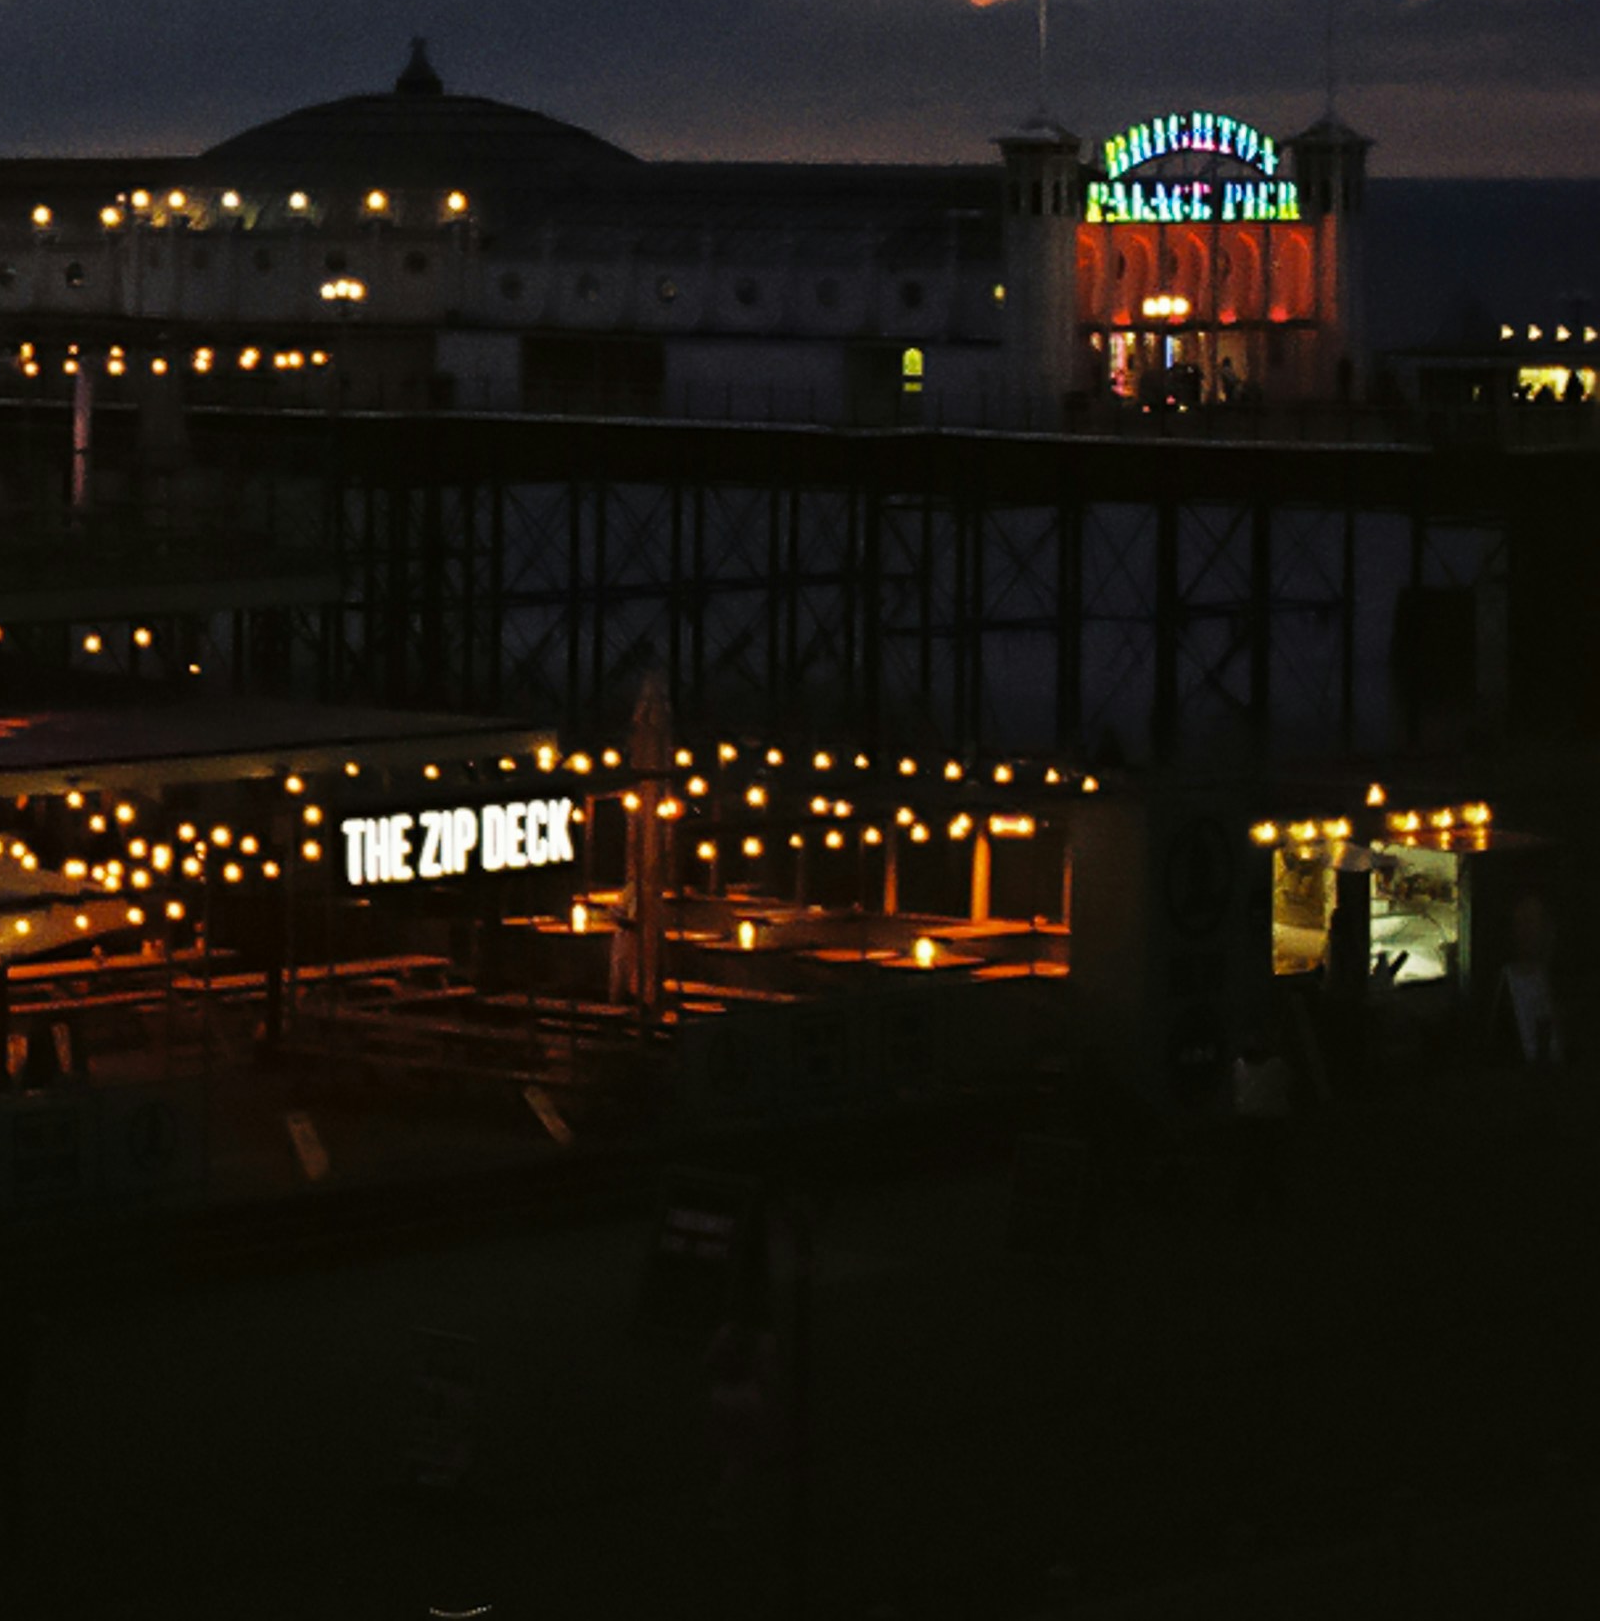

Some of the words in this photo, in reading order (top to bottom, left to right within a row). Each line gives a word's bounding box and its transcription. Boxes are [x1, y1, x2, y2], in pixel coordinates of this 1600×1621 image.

[1086, 182, 1212, 222] PALACE
[1221, 182, 1300, 221] PIER
[342, 813, 414, 885] THE
[418, 807, 478, 878] ZIP
[481, 797, 574, 872] DECK
